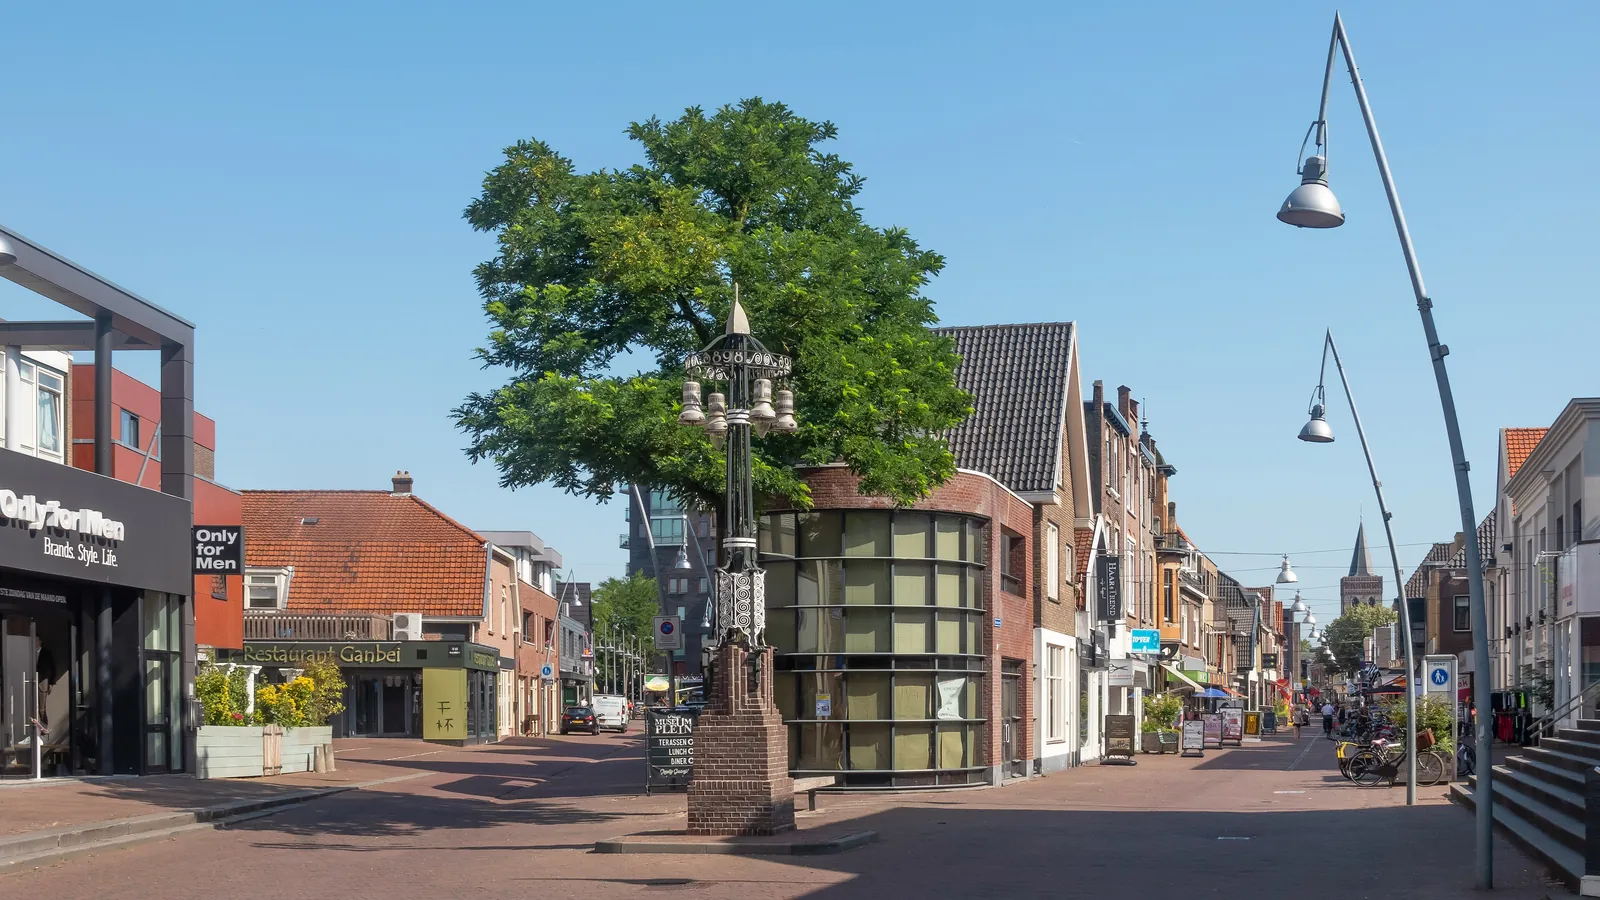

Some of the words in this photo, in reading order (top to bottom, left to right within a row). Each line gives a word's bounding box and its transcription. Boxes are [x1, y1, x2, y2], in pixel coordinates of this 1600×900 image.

[0, 489, 47, 530] Only
[46, 500, 80, 531] for
[79, 508, 125, 541] Men
[196, 529, 238, 545] Only
[44, 536, 75, 559] Brands.
[78, 543, 99, 567] Style.
[102, 548, 118, 567] Life.
[196, 542, 225, 556] for
[195, 557, 237, 570] Men
[243, 645, 335, 664] Restaurant
[340, 643, 401, 664] Ganbei
[655, 718, 692, 727] MUSEUM
[655, 725, 692, 734] PLEIN
[668, 748, 688, 756] LUNCH
